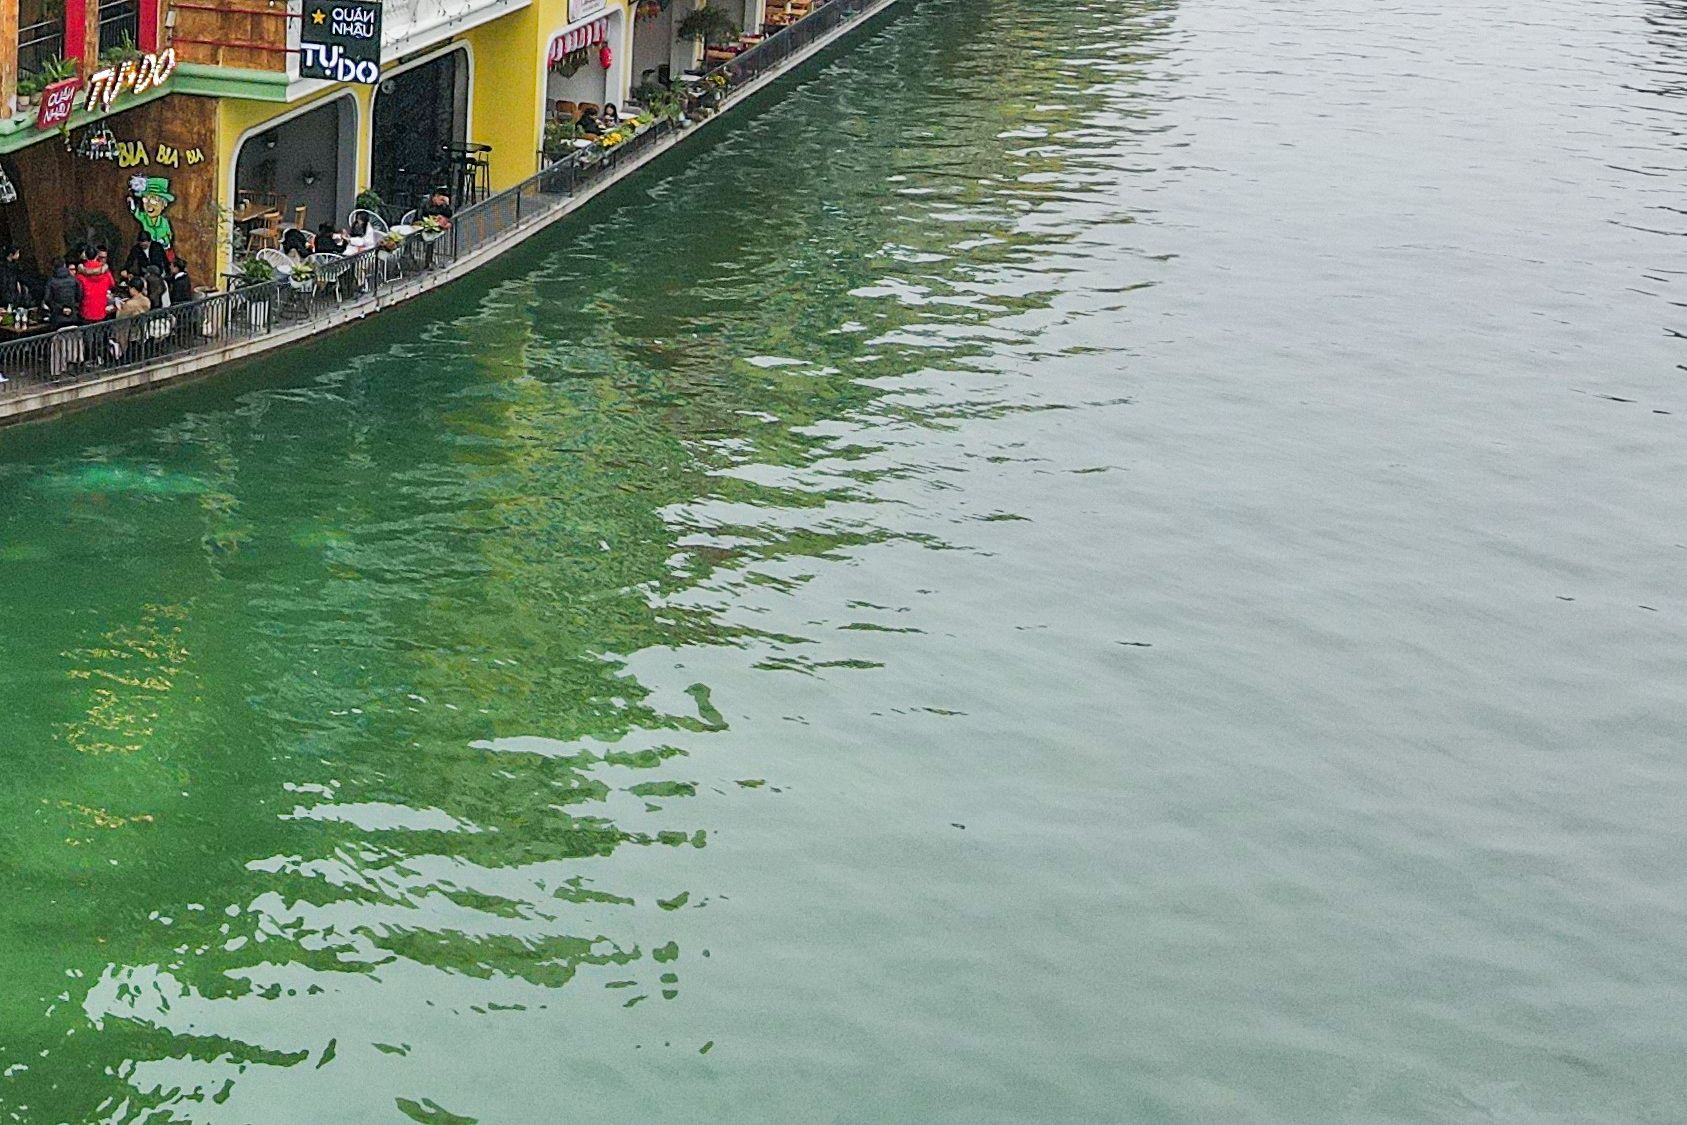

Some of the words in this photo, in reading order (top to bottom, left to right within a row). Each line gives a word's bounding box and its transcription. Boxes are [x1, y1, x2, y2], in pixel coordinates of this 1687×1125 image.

[332, 7, 375, 23] QUÁN
[332, 22, 374, 39] NHẬU
[133, 47, 175, 95] DO
[301, 42, 343, 76] TỰ
[337, 58, 379, 84] DO
